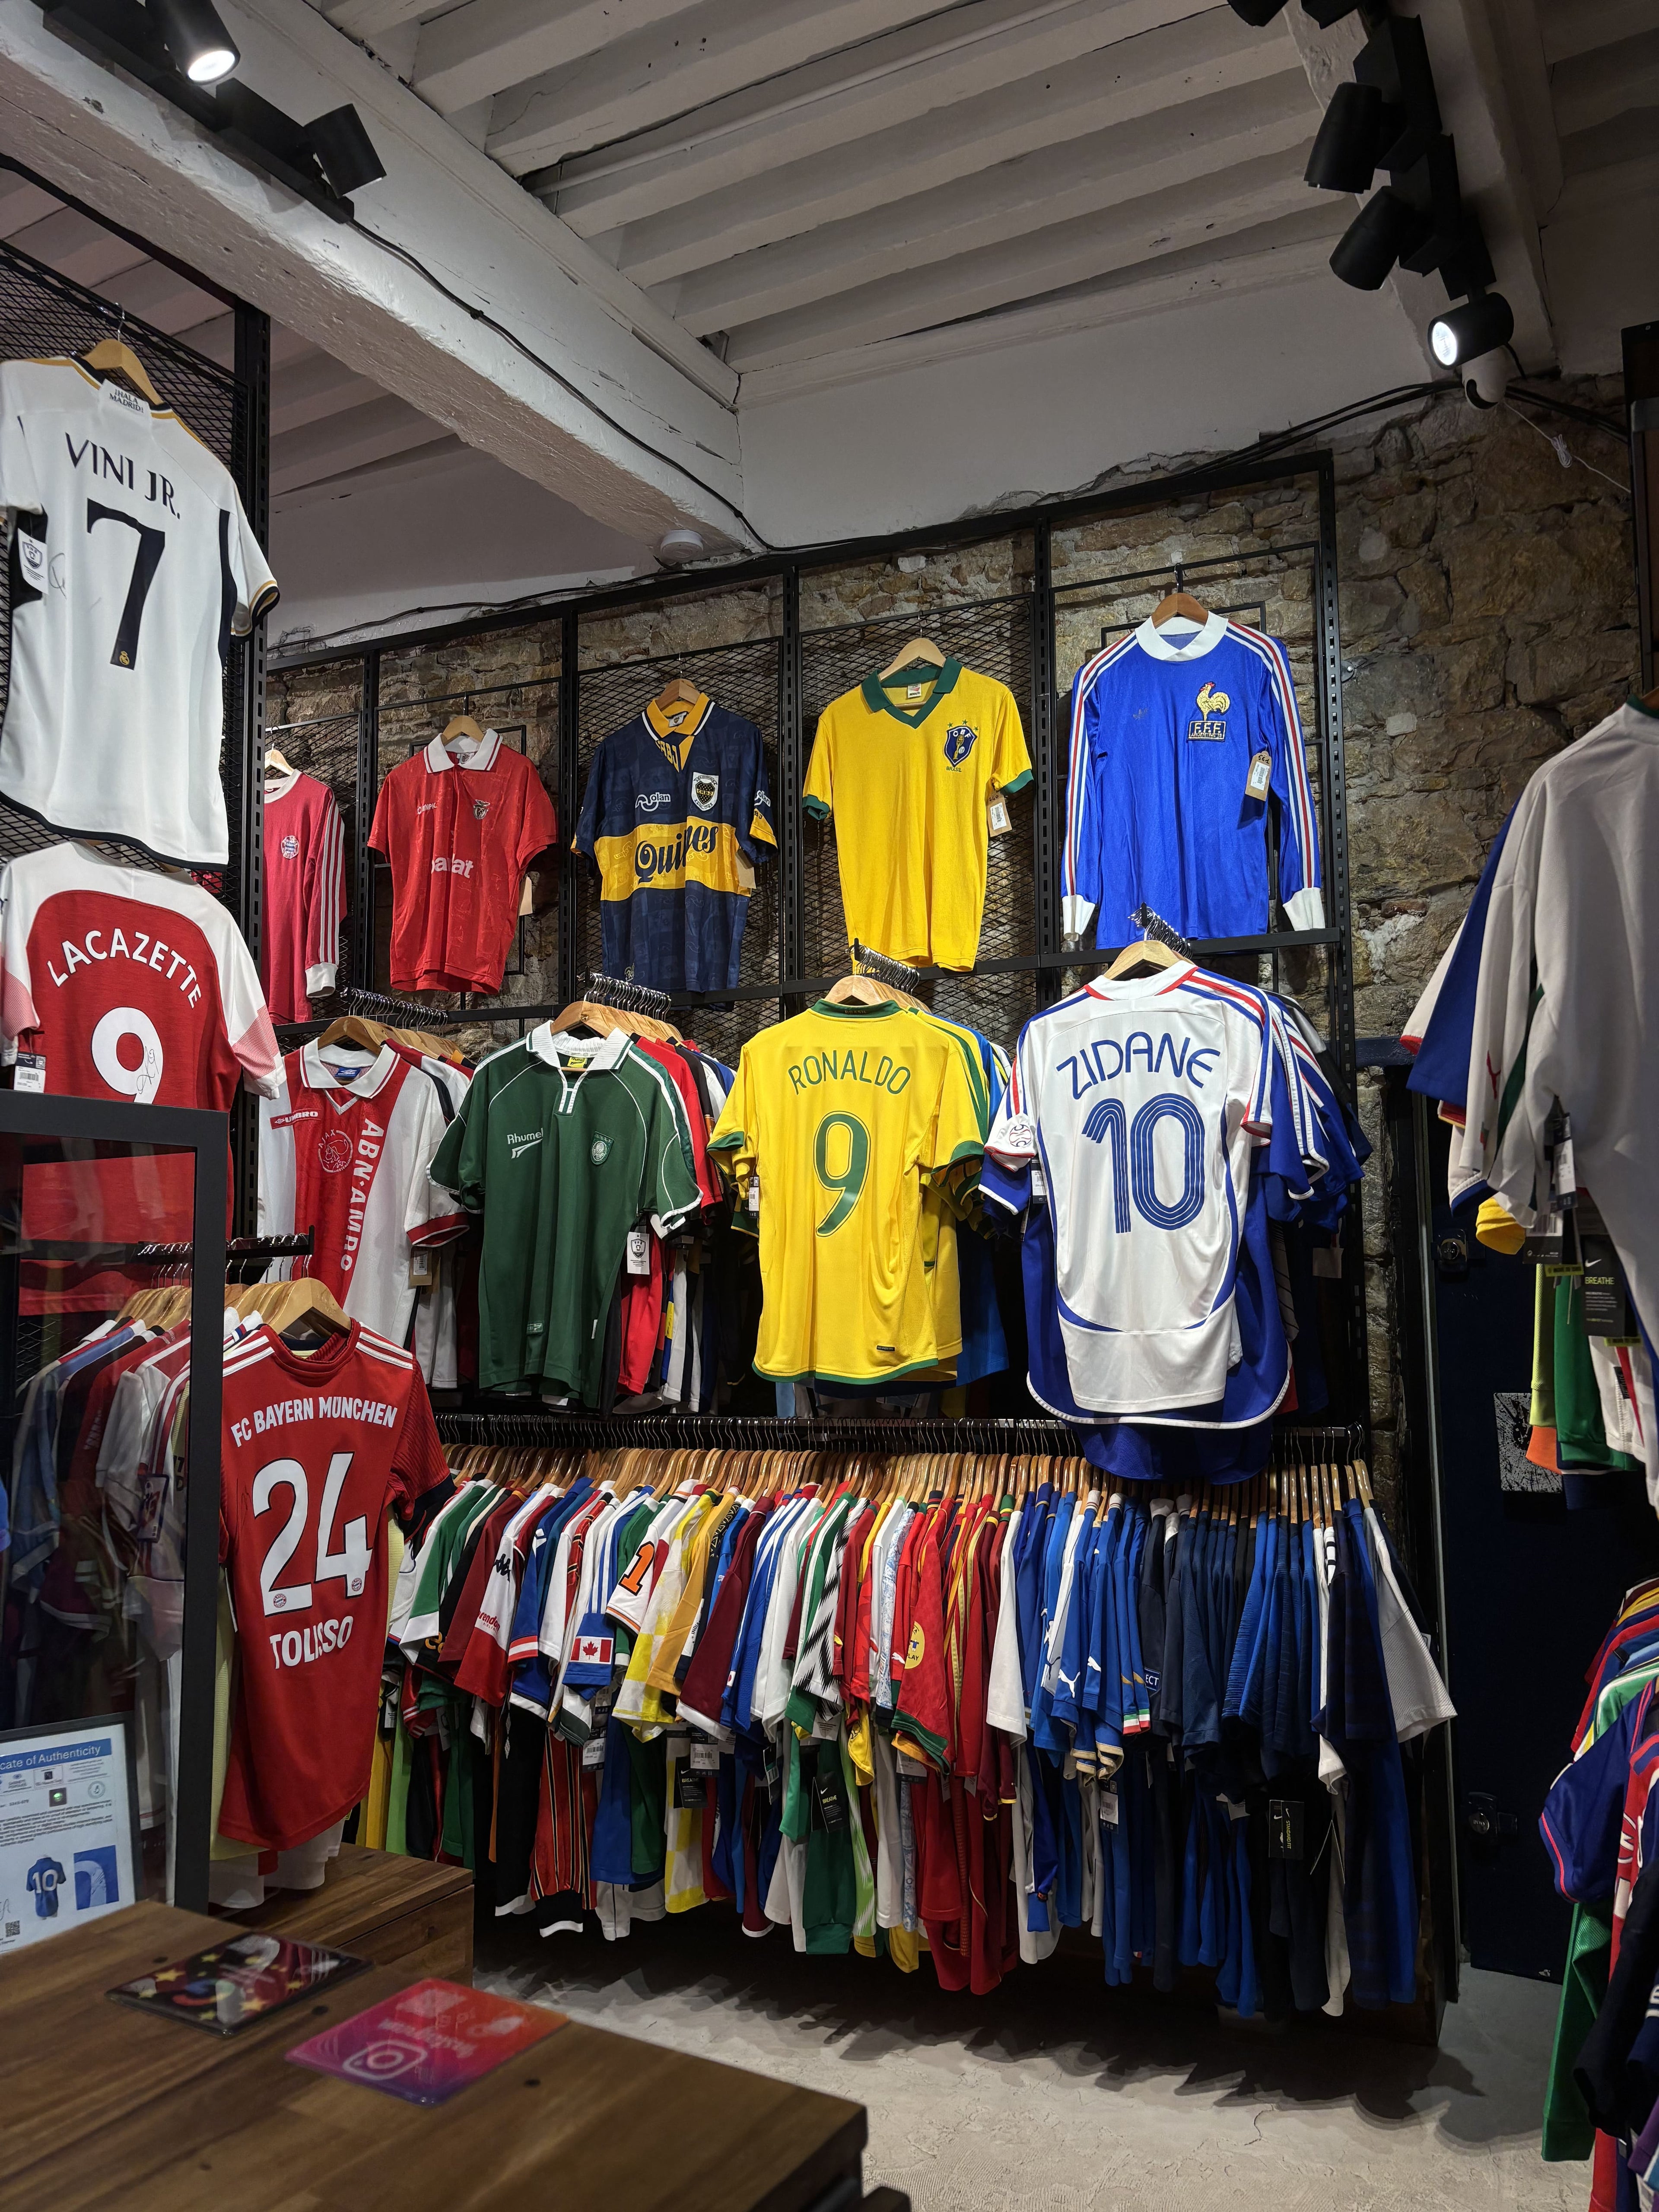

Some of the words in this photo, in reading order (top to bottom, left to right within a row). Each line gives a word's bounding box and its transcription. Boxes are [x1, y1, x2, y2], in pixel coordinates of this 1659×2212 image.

[110, 393, 144, 413] MADRID!
[65, 432, 134, 491] VINI
[145, 470, 181, 519] JR.
[87, 498, 166, 671] 7
[635, 825, 719, 886] Quiles
[47, 928, 202, 1009] LACAZETTE
[91, 1006, 164, 1104] 9
[788, 1049, 911, 1095] RONALDO
[1056, 1031, 1220, 1100] ZIDANE
[285, 1111, 318, 1123] UMBRO
[318, 1128, 336, 1149] AJAX
[813, 1109, 872, 1238] 9
[1081, 1093, 1205, 1234] 10
[1584, 1276, 1615, 1285] BREATHE
[231, 1417, 252, 1448] FC
[253, 1397, 314, 1434] BAYERN
[319, 1396, 398, 1428] MÜNCHEN
[252, 1452, 374, 1618] 24
[0, 1759, 23, 1770] cate
[26, 1755, 36, 1766] of
[38, 1745, 100, 1764] Authenticity
[822, 1795, 837, 1804] BREATHE
[32, 1869, 59, 1894] 10
